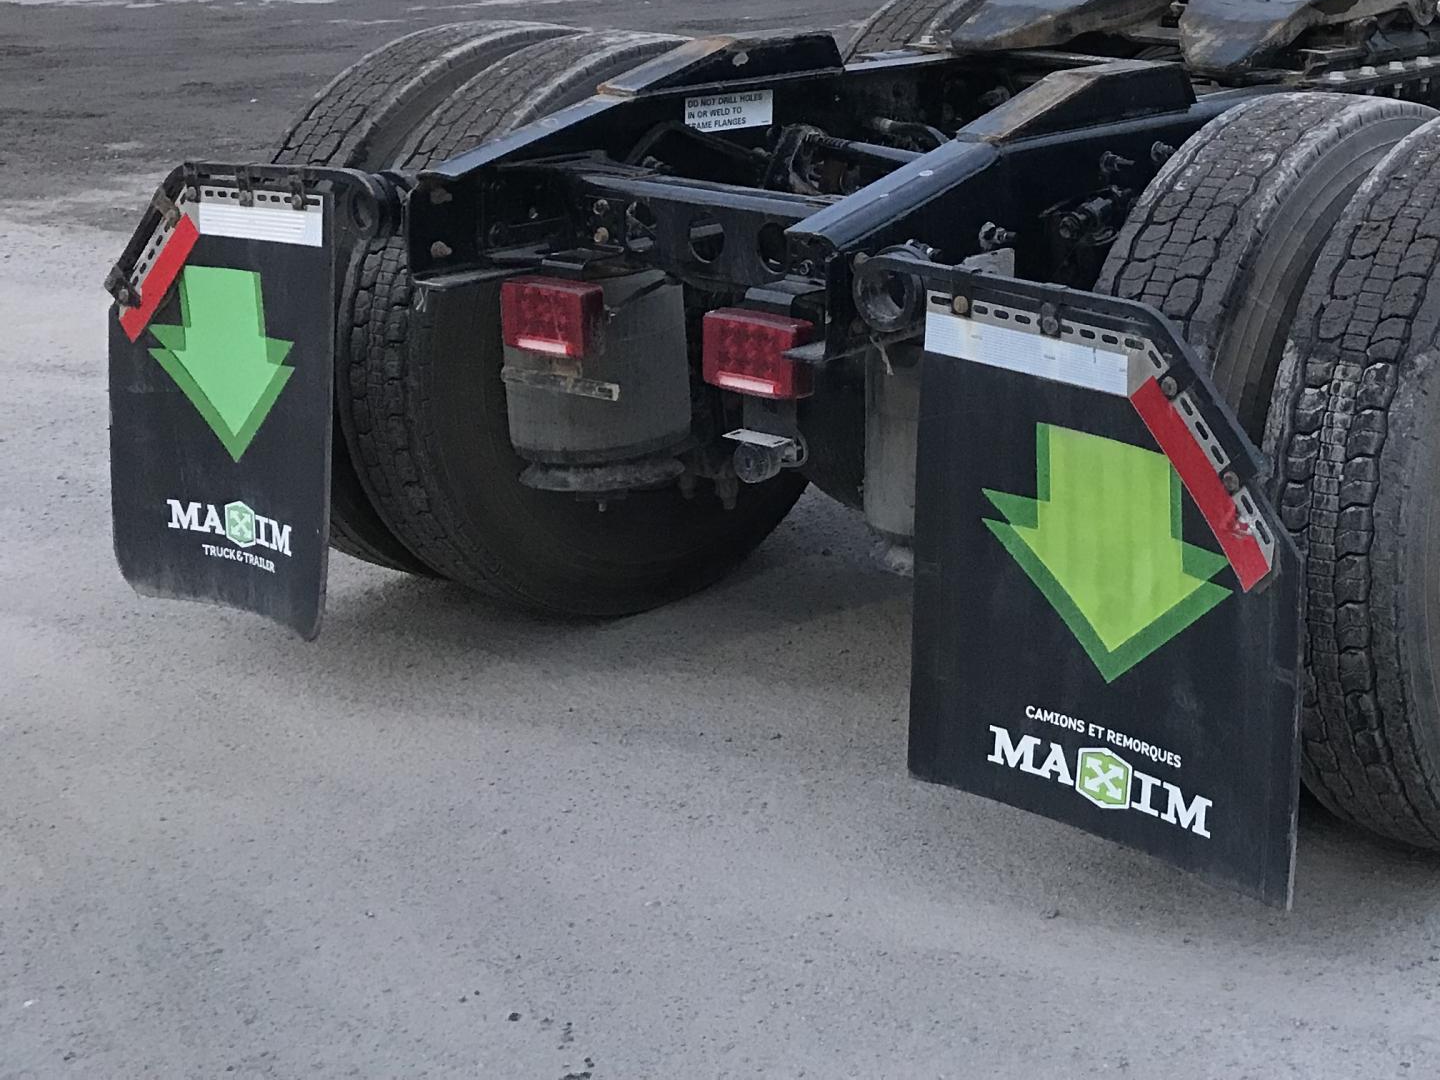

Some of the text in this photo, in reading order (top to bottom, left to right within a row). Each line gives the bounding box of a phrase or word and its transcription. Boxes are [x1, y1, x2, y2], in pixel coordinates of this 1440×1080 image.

[687, 107, 742, 119] IN OR WELD TO
[700, 98, 716, 107] NOT
[718, 95, 738, 105] DRILL
[740, 93, 763, 102] HOLES
[714, 117, 746, 128] FLANGES
[166, 499, 292, 557] MAXIM
[1025, 705, 1182, 769] CAMIONS ET REMORQUES
[987, 724, 1214, 840] MAXIM
